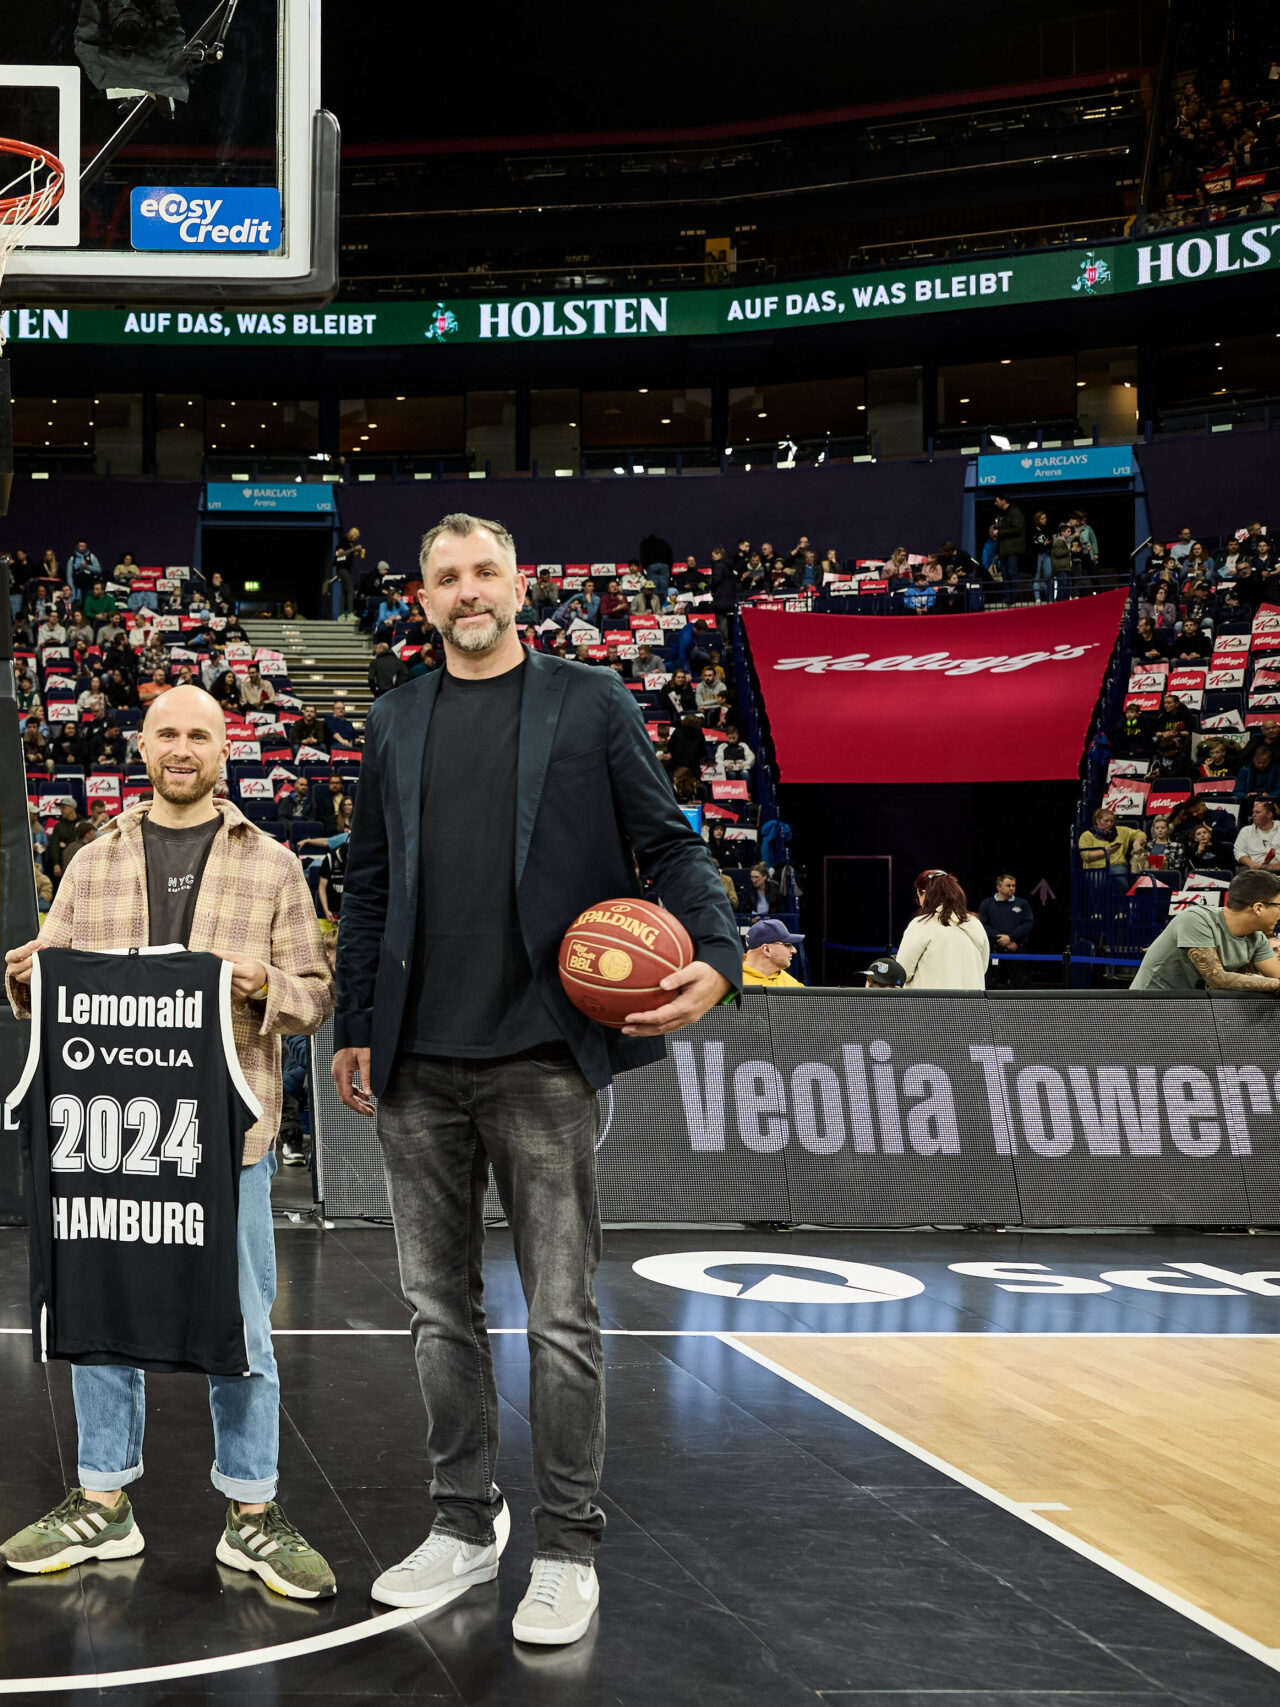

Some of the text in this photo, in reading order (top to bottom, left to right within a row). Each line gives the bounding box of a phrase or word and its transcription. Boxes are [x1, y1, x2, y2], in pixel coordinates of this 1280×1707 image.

[179, 218, 272, 244] Credit
[1137, 224, 1280, 285] HOLS
[727, 270, 1013, 321] AUF DAS, WAS BLEIBT
[124, 313, 377, 337] AUF DAS, WAS BLEIBT
[479, 297, 668, 339] HOLSTEN
[1034, 455, 1088, 467] BARCLAYS
[1034, 468, 1062, 477] Arena
[1113, 466, 1130, 475] U13
[980, 475, 996, 484] U12
[253, 488, 297, 498] BARCLAYS
[253, 499, 276, 507] Arena
[317, 503, 331, 511] U12
[773, 644, 1092, 675] Kellogg's
[168, 874, 194, 887] NYC
[573, 910, 657, 950] SPALDING
[570, 955, 593, 972] BBL
[57, 986, 203, 1029] Lemonaid
[100, 1047, 194, 1068] VEOLIA
[672, 1040, 1280, 1157] Veolia Tower
[49, 1094, 203, 1178] 2024
[52, 1196, 205, 1247] HAMBURG
